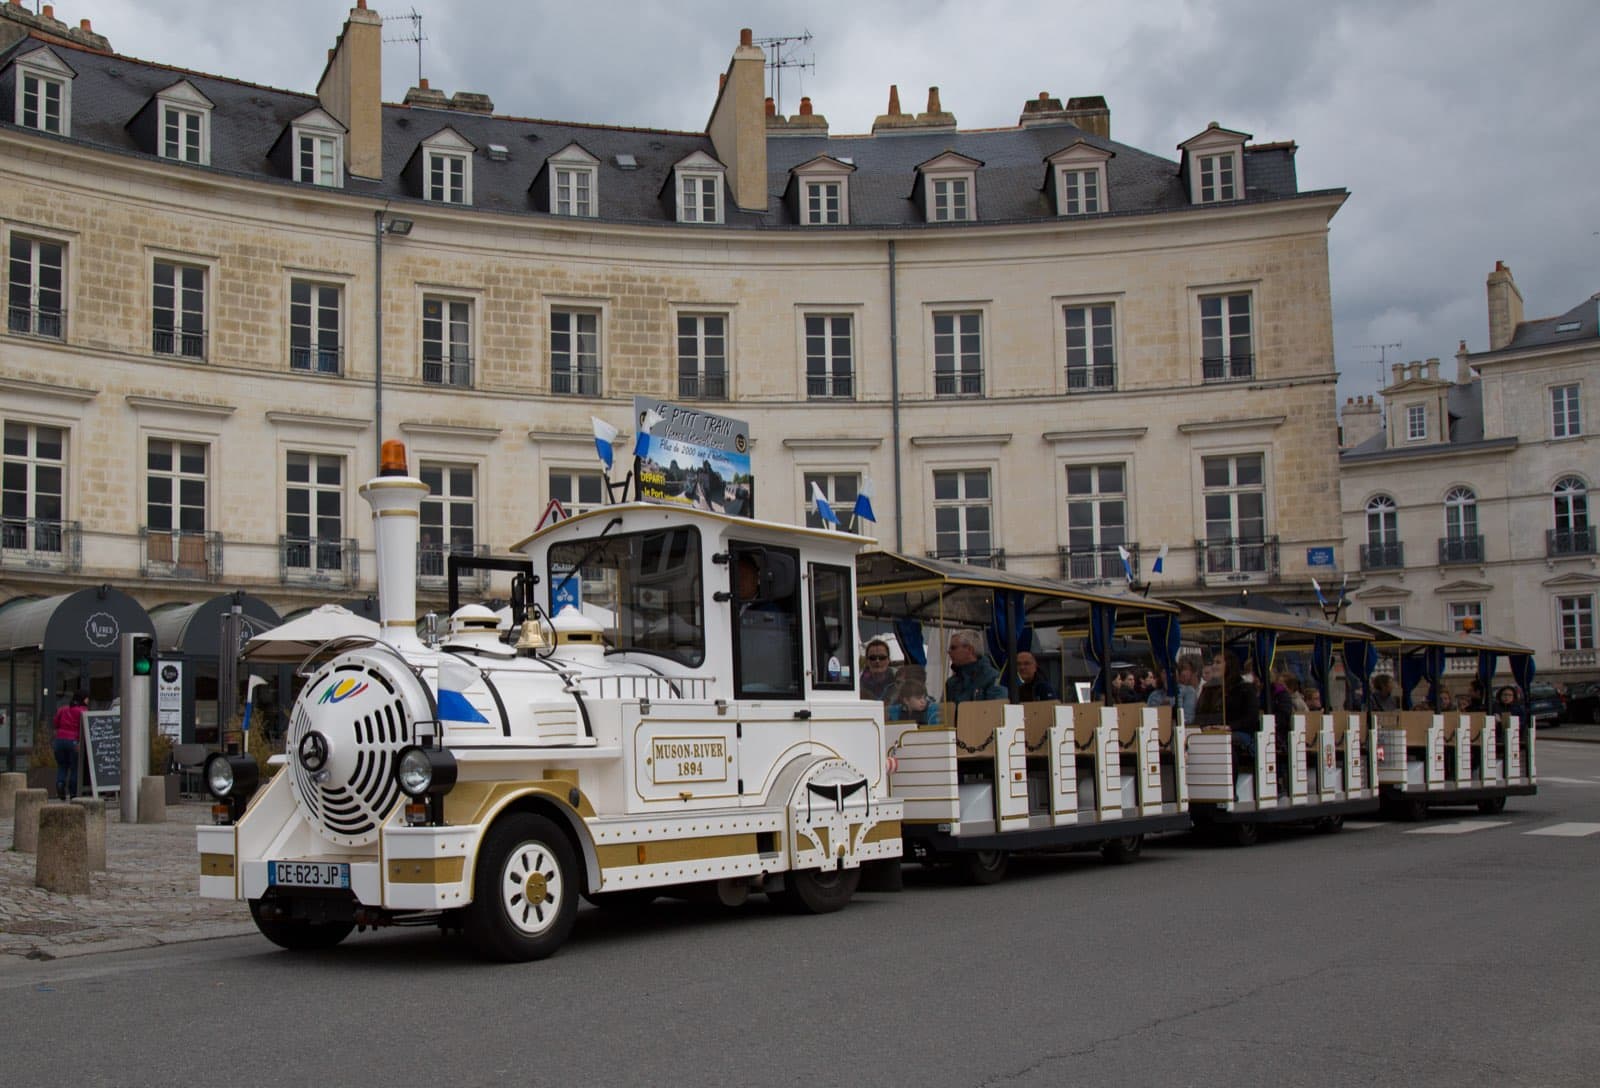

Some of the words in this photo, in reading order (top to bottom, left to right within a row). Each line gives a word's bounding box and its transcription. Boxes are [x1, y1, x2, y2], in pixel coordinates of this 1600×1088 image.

[672, 408, 701, 428] P'TIT
[703, 416, 734, 437] TRAIN
[681, 445, 696, 456] 2000
[651, 487, 664, 499] Port
[678, 761, 703, 777] 1894
[277, 864, 339, 885] CE-623-JP
